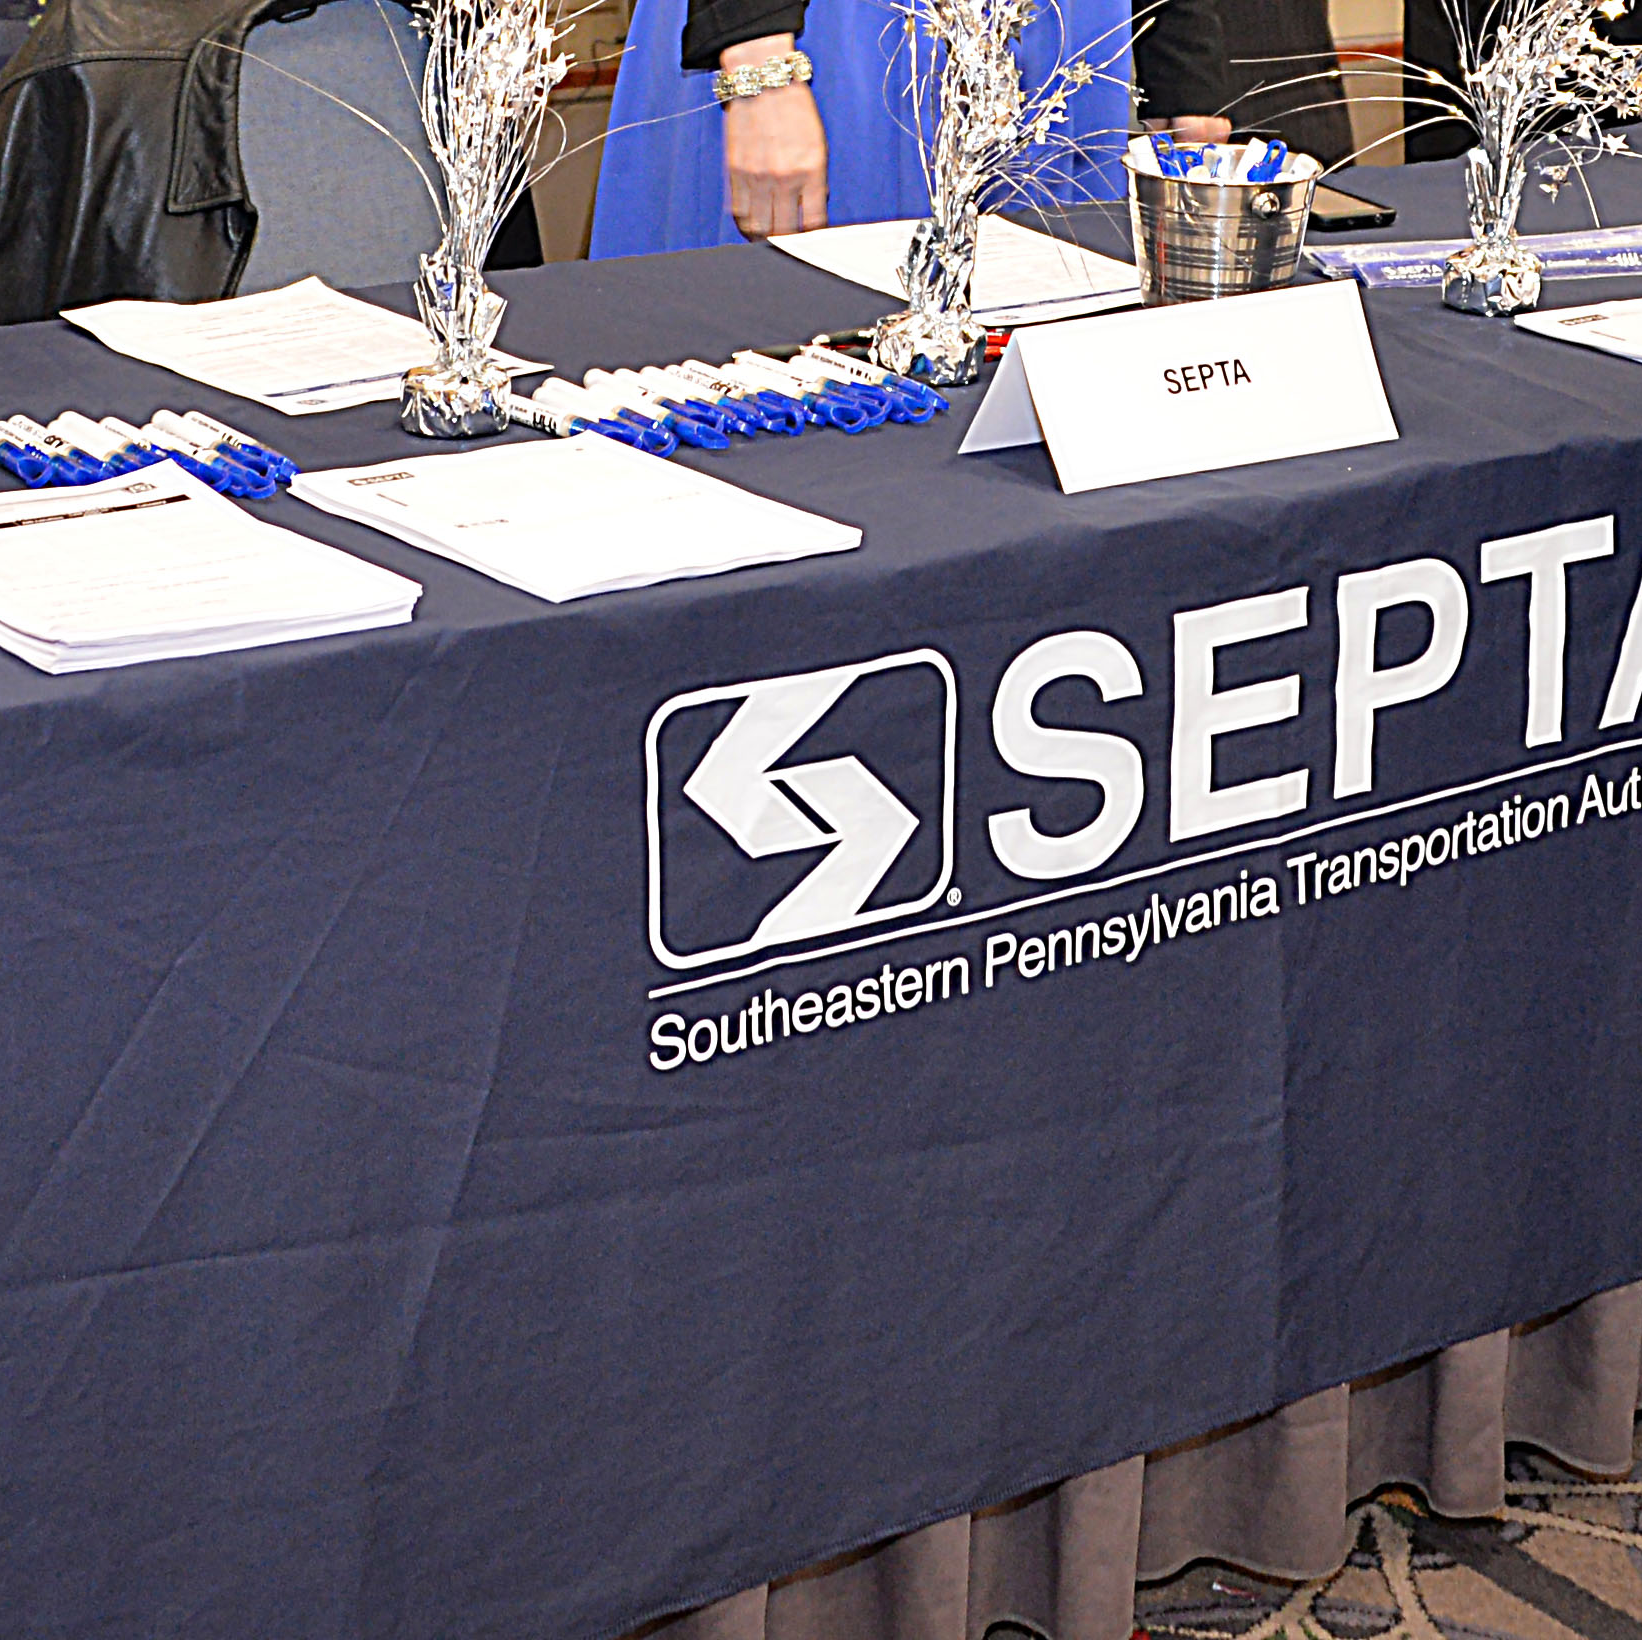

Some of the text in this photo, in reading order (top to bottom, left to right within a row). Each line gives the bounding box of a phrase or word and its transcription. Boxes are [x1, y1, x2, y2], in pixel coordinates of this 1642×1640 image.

[1163, 358, 1252, 394] SEPTA
[649, 957, 970, 1071] Southeastern
[984, 869, 1280, 988] Pennsylvania
[1286, 793, 1570, 906] Transportation
